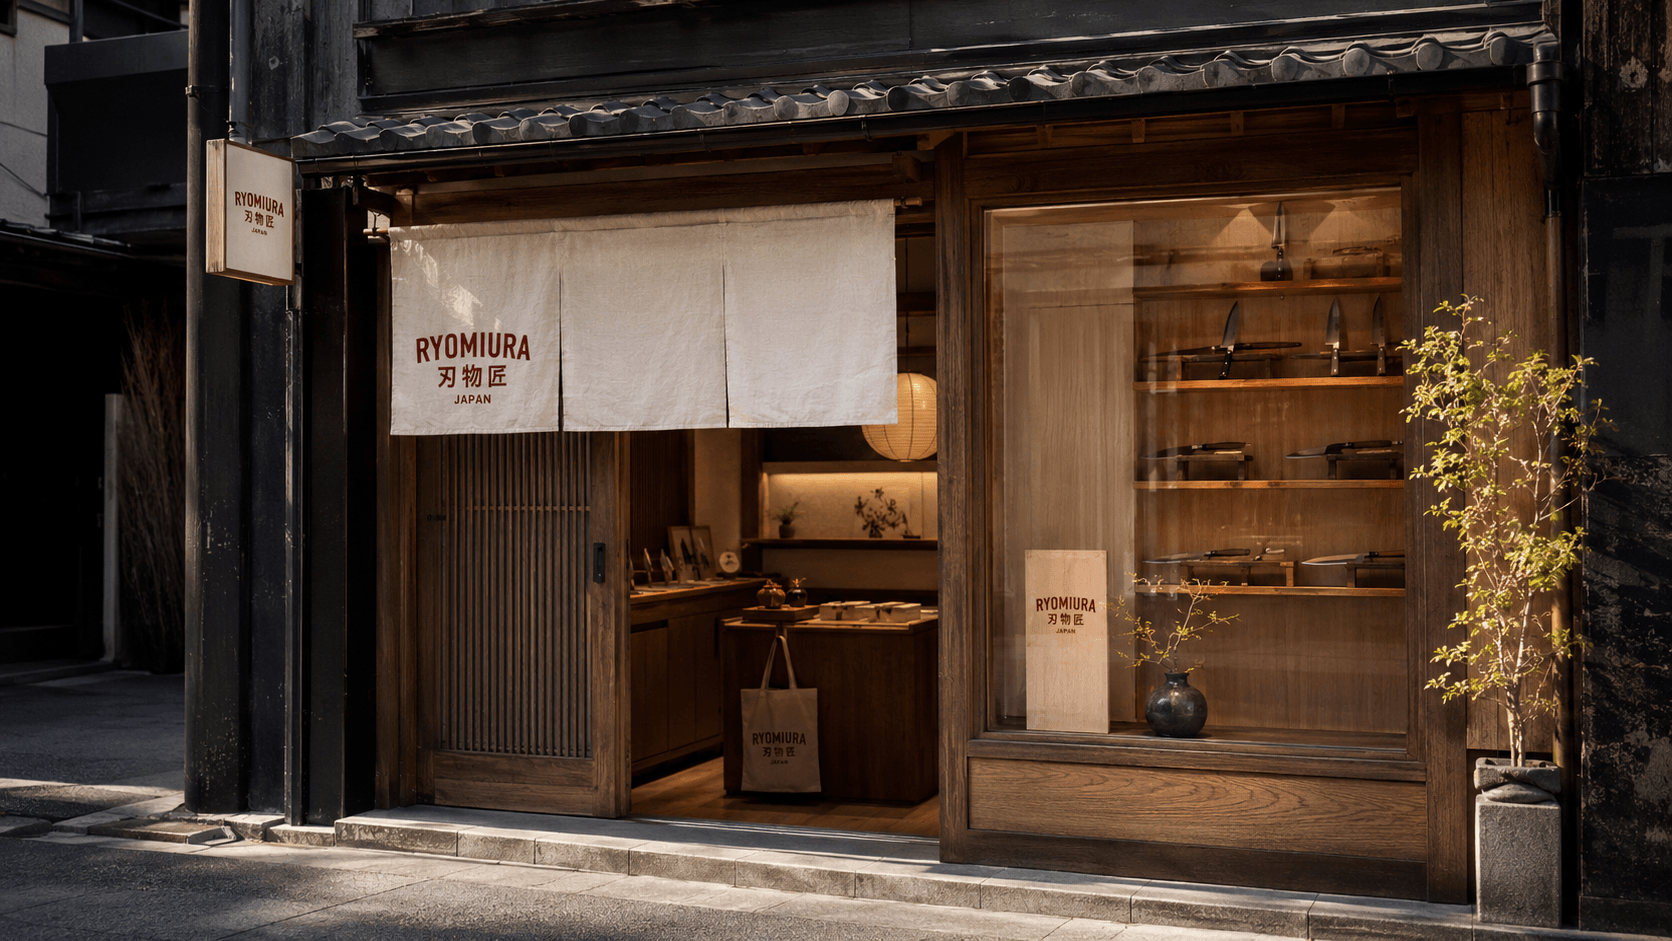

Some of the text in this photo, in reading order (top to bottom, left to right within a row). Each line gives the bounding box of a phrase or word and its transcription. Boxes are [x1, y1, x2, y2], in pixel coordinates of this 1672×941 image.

[235, 191, 284, 217] RYOMIURA
[244, 210, 274, 228] 刃物匠
[416, 332, 531, 364] RYOMIURA
[438, 364, 507, 388] 刃物匠
[454, 394, 491, 404] JAPAN
[1036, 596, 1096, 613] RYOMIURA
[1048, 613, 1084, 626] 刃物匠
[752, 731, 807, 746] RYOMIURA
